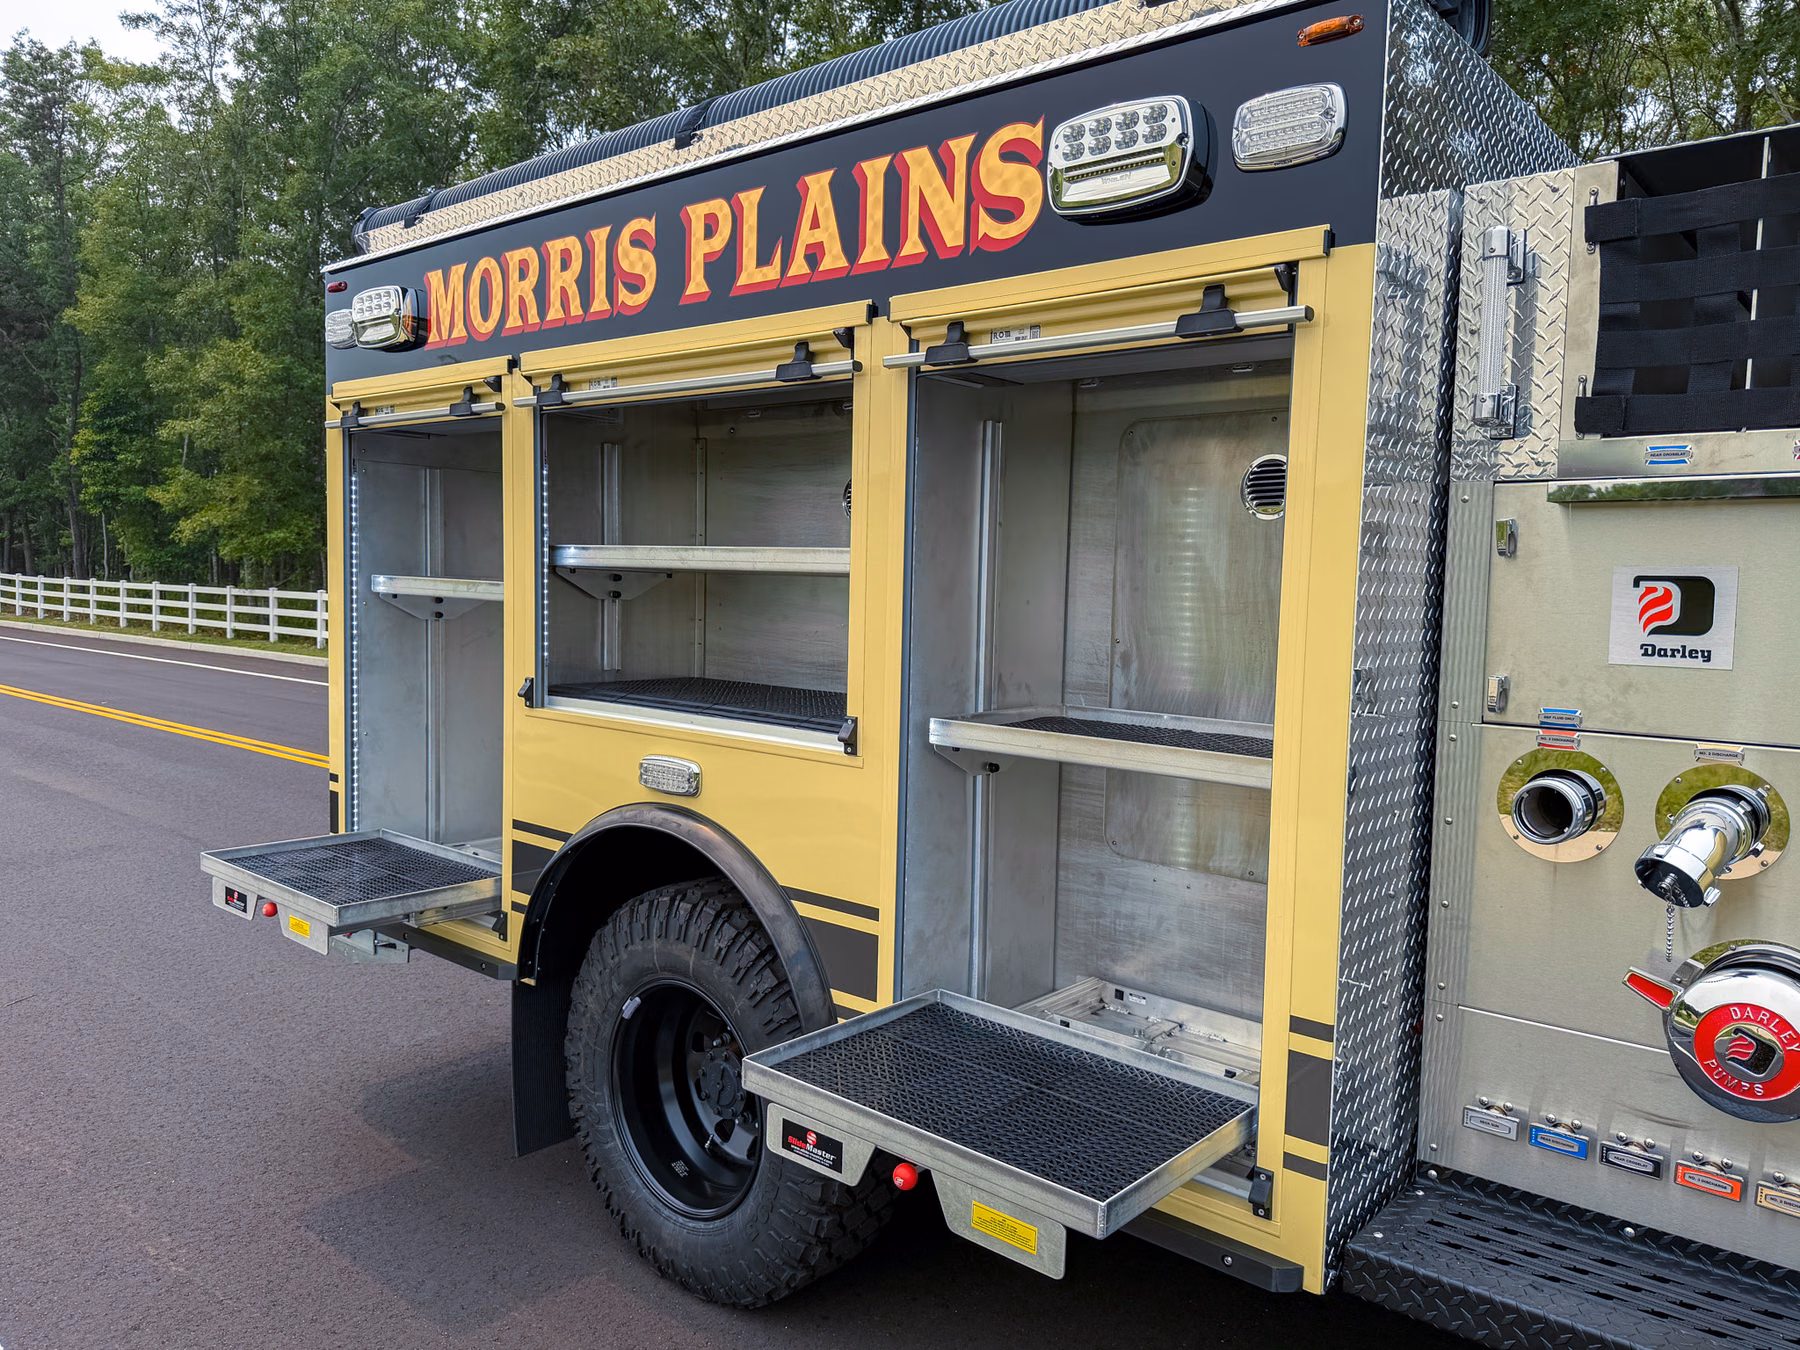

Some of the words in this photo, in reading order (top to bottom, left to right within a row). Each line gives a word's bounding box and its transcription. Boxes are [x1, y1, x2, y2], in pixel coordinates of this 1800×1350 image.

[424, 212, 658, 351] MORRIS
[679, 113, 1045, 305] PLAINS
[1640, 643, 1712, 663] Darley
[1729, 1007, 1800, 1051] DARLEY
[1704, 1058, 1764, 1096] PUMPS
